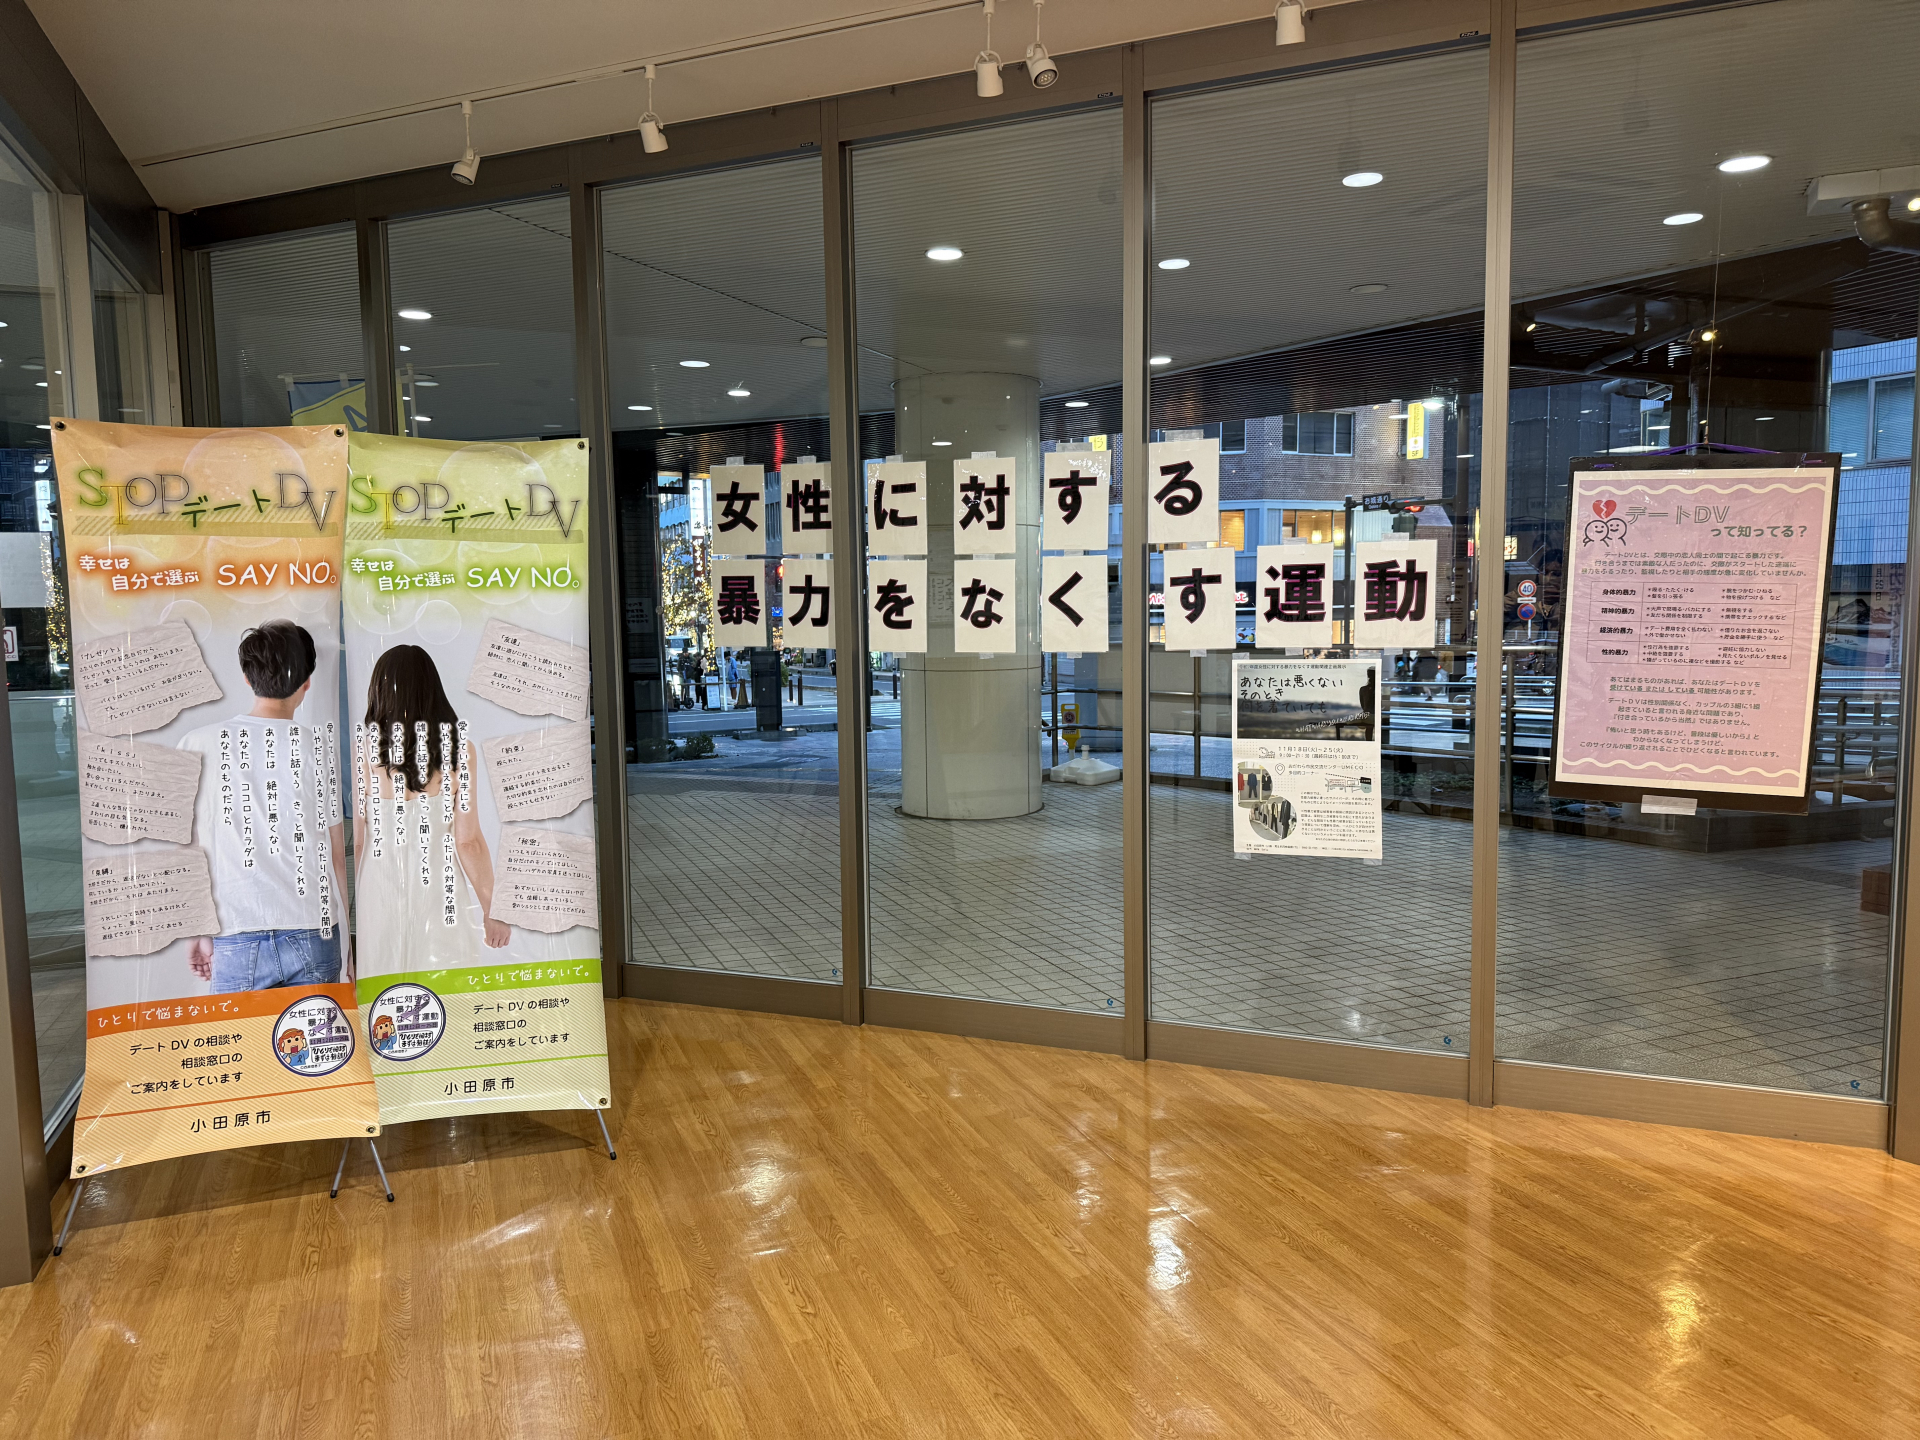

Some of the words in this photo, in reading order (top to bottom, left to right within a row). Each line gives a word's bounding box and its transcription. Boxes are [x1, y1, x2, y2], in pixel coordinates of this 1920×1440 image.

[274, 473, 337, 532] DV
[525, 483, 581, 538] DV
[716, 460, 1203, 533] 女性に対する
[1625, 505, 1730, 525] デートDV
[1710, 525, 1808, 538] って知ってる？
[79, 554, 130, 572] 幸せは
[217, 563, 278, 586] SAY
[351, 558, 394, 573] 幸せは
[466, 567, 521, 588] SAY
[112, 568, 200, 591] 自分で選ぶ
[378, 571, 456, 591] 自分で選ぶ
[1522, 585, 1533, 593] 40
[1602, 588, 1636, 596] 身体的暴力
[717, 559, 1428, 630] 暴力をなくす運動
[1240, 674, 1343, 688] あなたは悪くない
[1240, 688, 1284, 701] そのとき
[1240, 699, 1327, 713] 何を着ていても
[239, 728, 250, 770] あなたの
[265, 727, 275, 769] あなたは
[289, 726, 301, 789] 誰かに話そう
[370, 724, 379, 763] あなたの
[393, 723, 403, 763] あなたは
[416, 723, 427, 783] 誰かに話そう
[220, 729, 233, 826] あなたのものだから
[314, 726, 326, 830] いやだといえることが
[327, 722, 338, 818] 愛している相手にも
[356, 724, 366, 817] あなたのものだから
[441, 723, 454, 823] いやだといえることが
[457, 721, 469, 812] 愛している相手にも
[266, 780, 280, 855] 絶対に悪くない
[371, 776, 383, 858] ココロとカラダは
[394, 774, 406, 845] 絶対に悪くない
[241, 783, 255, 868] ココロとカラダは
[419, 794, 430, 886] きっと聞いてくれる
[293, 801, 305, 896] きっと聞いてくれる
[318, 842, 331, 938] ふたりの対等な関係
[443, 834, 456, 926] ふたりの対等な関係
[467, 965, 590, 985] ひとりで悩まないで。
[98, 999, 240, 1028] ひとりで悩まないで。
[379, 993, 430, 1006] 女性に対する
[473, 1003, 504, 1014] デート
[508, 1000, 524, 1011] DV
[527, 998, 570, 1010] の相談や
[396, 1012, 439, 1023] なくす運動
[473, 1019, 527, 1033] 相談窓口の
[130, 1041, 166, 1056] デート
[171, 1038, 190, 1051] DV
[194, 1033, 243, 1047] の相談や
[474, 1032, 570, 1050] ご案内をしています
[181, 1052, 243, 1069] 相談窓口の
[131, 1071, 243, 1095] ご案内をしています
[444, 1077, 515, 1096] 小田原市
[190, 1110, 272, 1133] 小田原市
